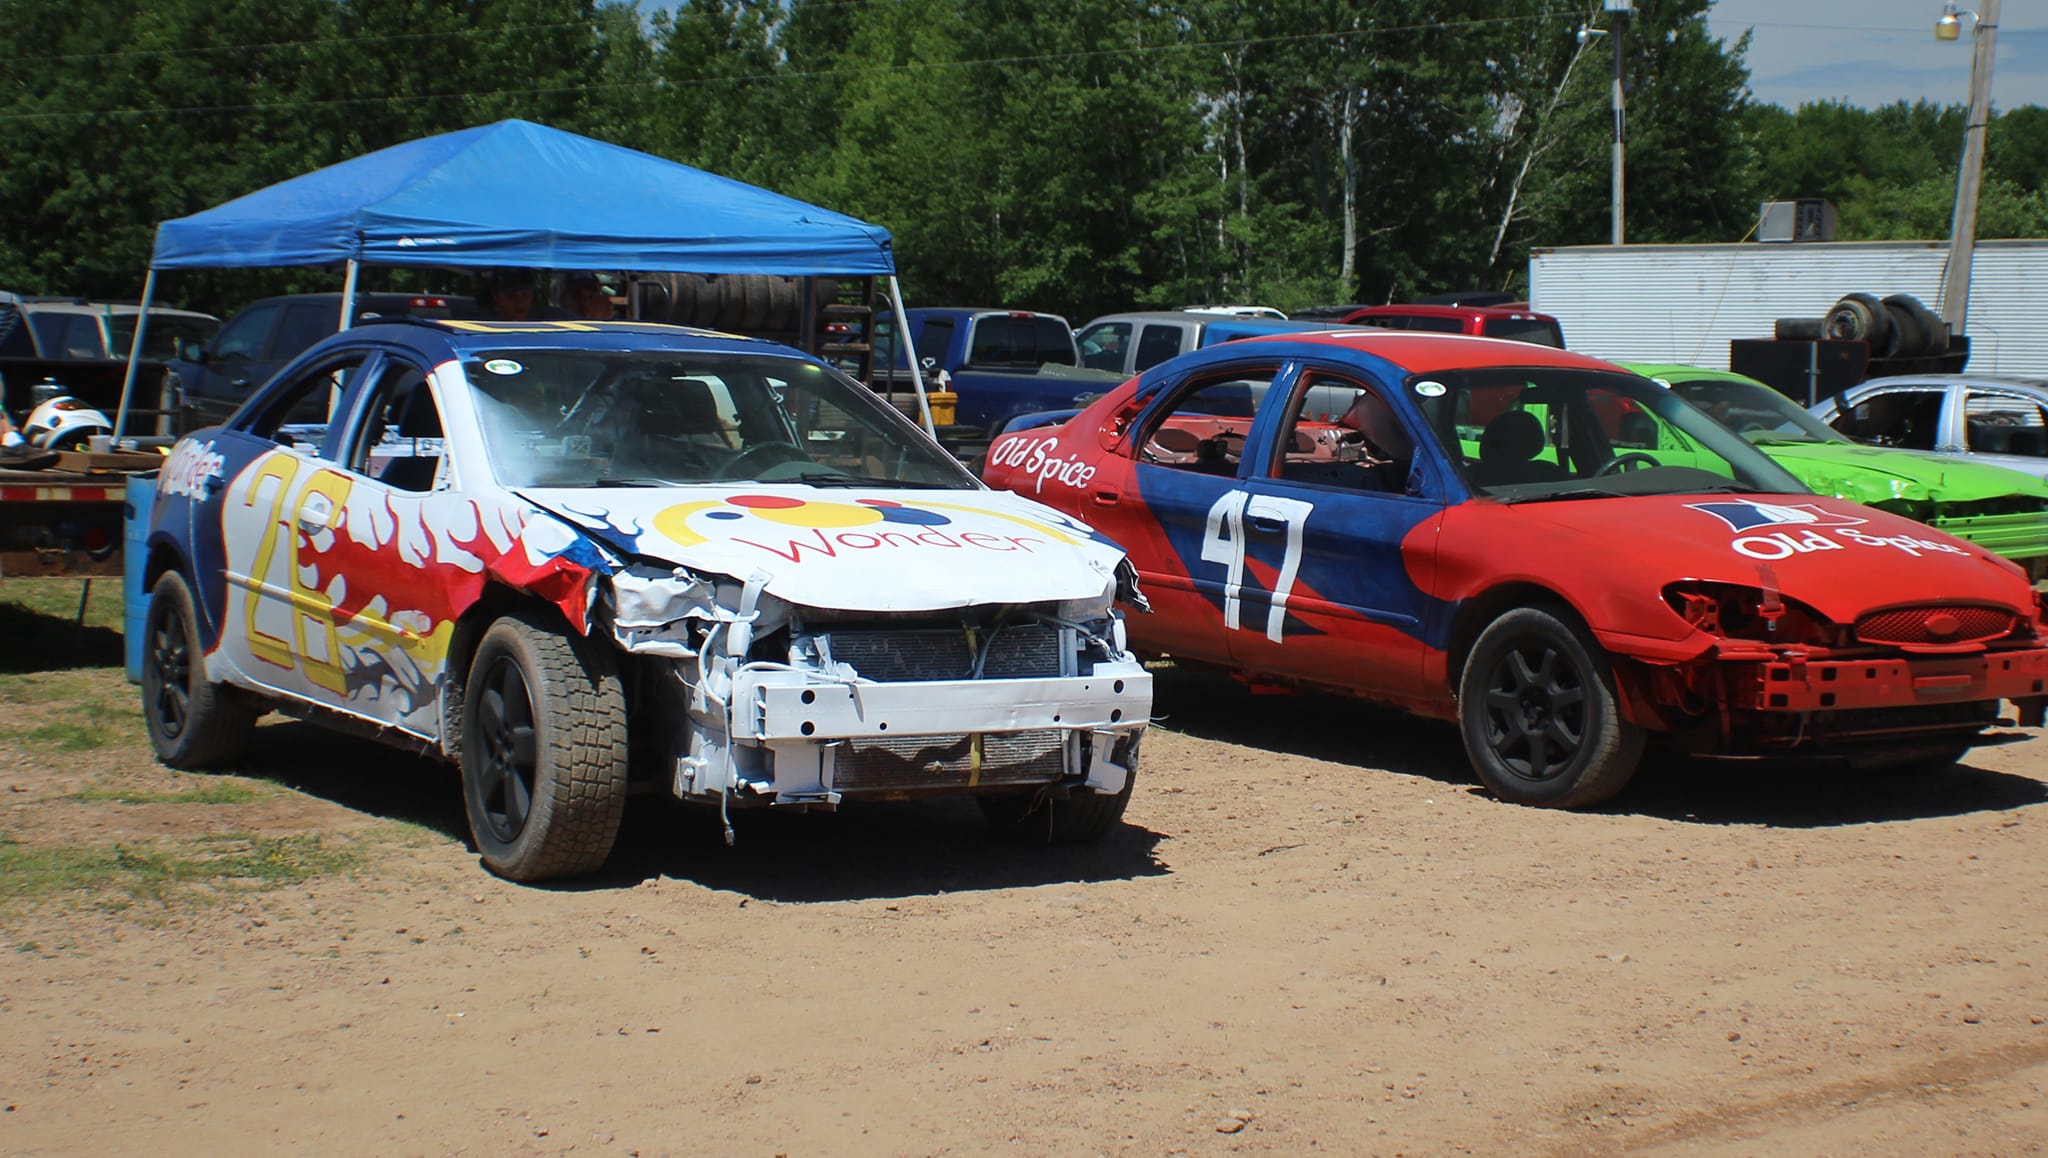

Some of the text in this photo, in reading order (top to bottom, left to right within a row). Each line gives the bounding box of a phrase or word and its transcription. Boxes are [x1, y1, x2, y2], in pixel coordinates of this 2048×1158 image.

[992, 437, 1096, 494] Old Spice
[730, 526, 1045, 563] Wonder
[1201, 489, 1314, 644] 47
[1732, 528, 1971, 560] Old Spice
